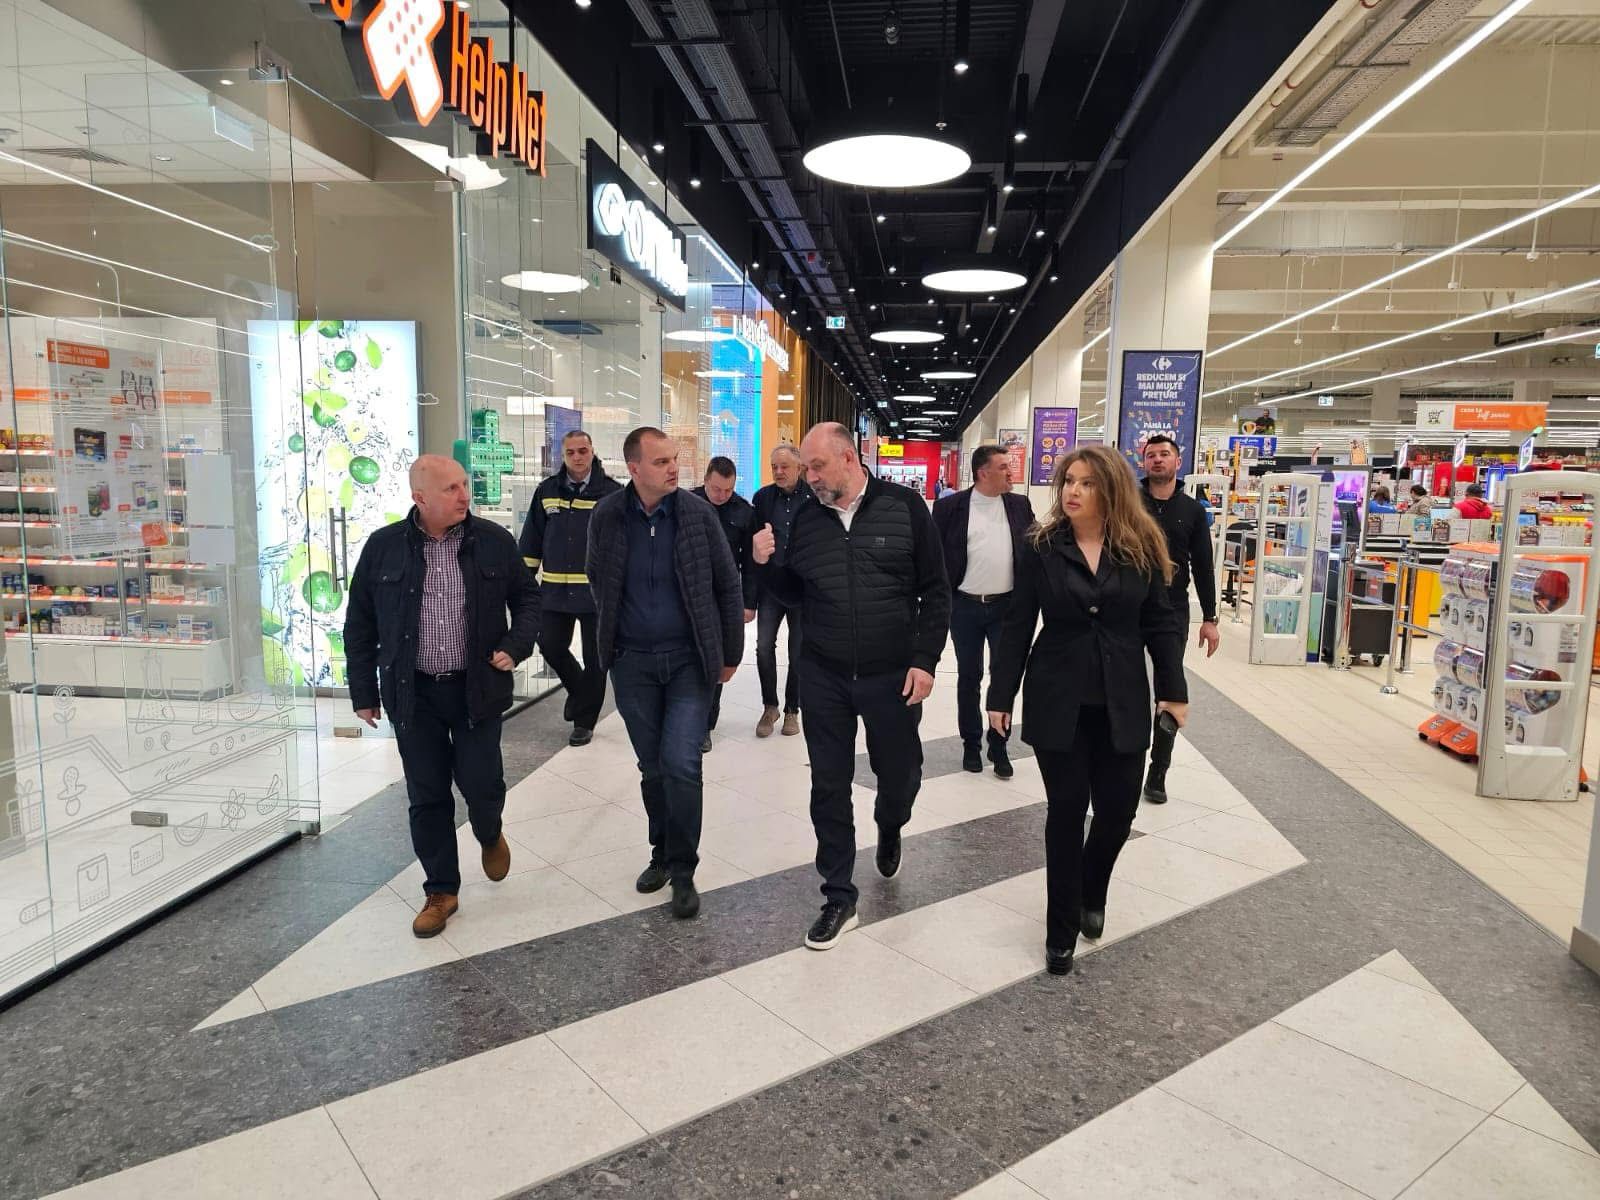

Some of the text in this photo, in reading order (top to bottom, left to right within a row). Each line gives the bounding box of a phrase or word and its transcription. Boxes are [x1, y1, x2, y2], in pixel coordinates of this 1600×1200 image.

[450, 1, 548, 178] Help Net
[1136, 373, 1177, 381] REDUCEM
[1138, 382, 1183, 390] MAI MULTE
[1247, 448, 1254, 457] 7
